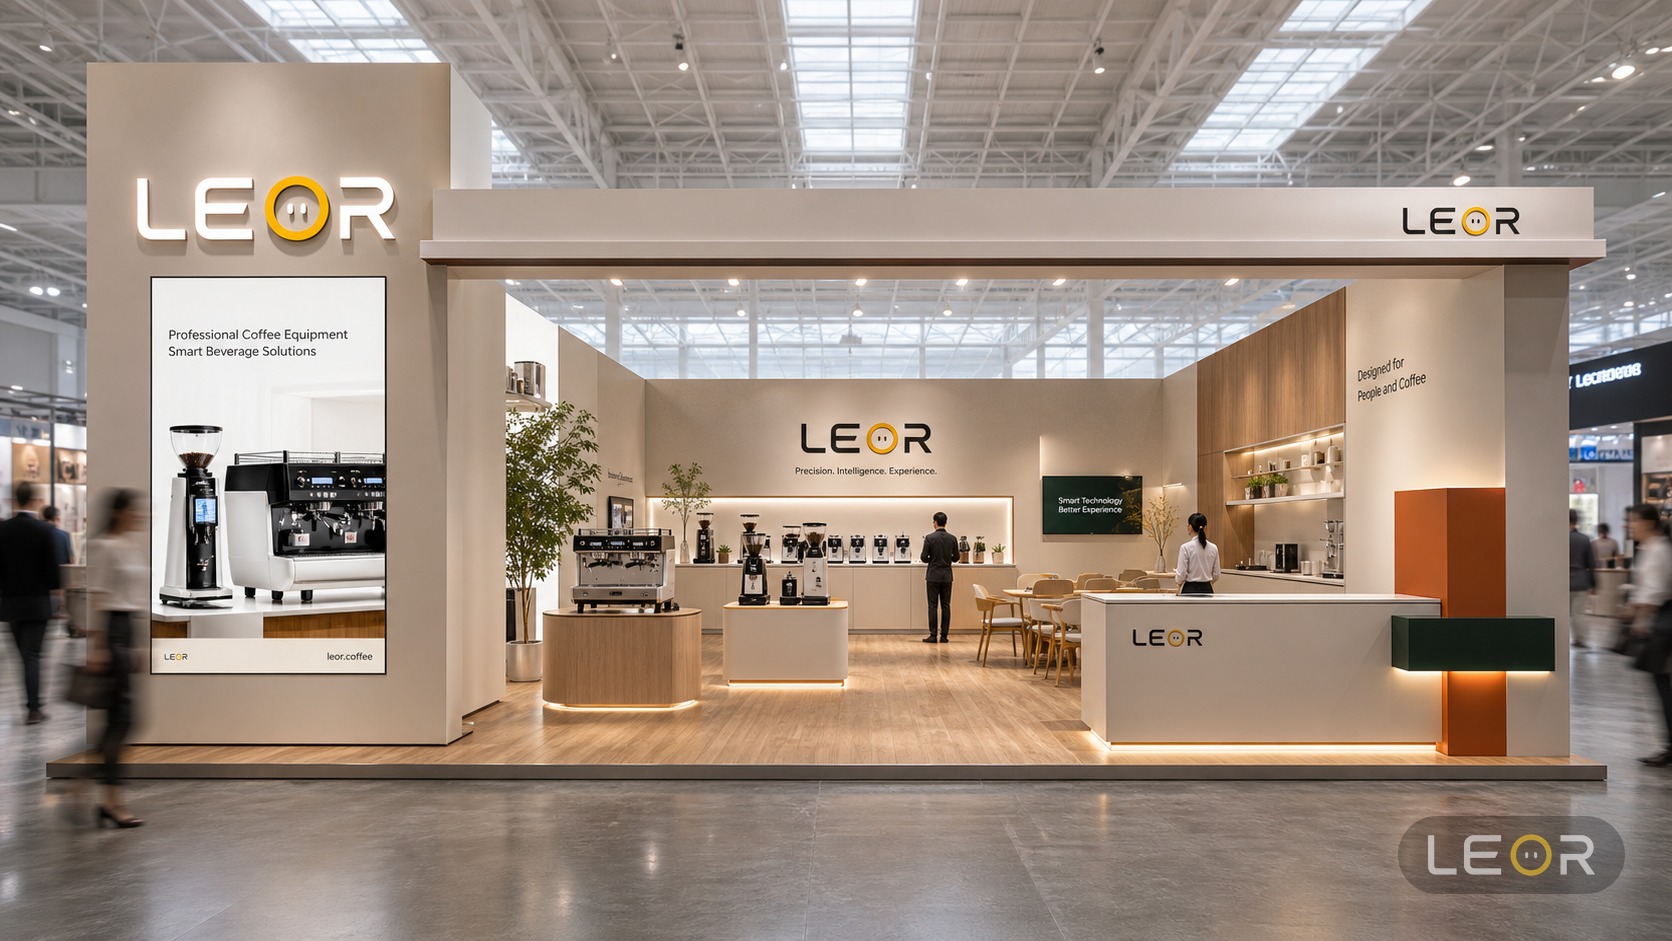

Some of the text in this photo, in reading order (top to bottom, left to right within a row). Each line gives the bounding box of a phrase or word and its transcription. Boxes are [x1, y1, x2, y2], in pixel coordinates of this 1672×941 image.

[137, 176, 396, 241] LEOR
[1402, 206, 1520, 236] LEOR
[168, 329, 348, 342] Professional Coffee Equipment
[168, 346, 317, 359] Smart Beverage Solutions
[1357, 357, 1405, 382] Designed for
[1357, 373, 1427, 402] People and Coffee
[800, 422, 932, 455] LEOR
[795, 466, 938, 477] Precision. Intelligence. Experience.
[1081, 497, 1123, 506] Technology
[1058, 506, 1123, 514] Better Experience
[1132, 628, 1203, 648] LEOR
[164, 653, 188, 661] LEOR
[326, 652, 373, 661] leor.coffee
